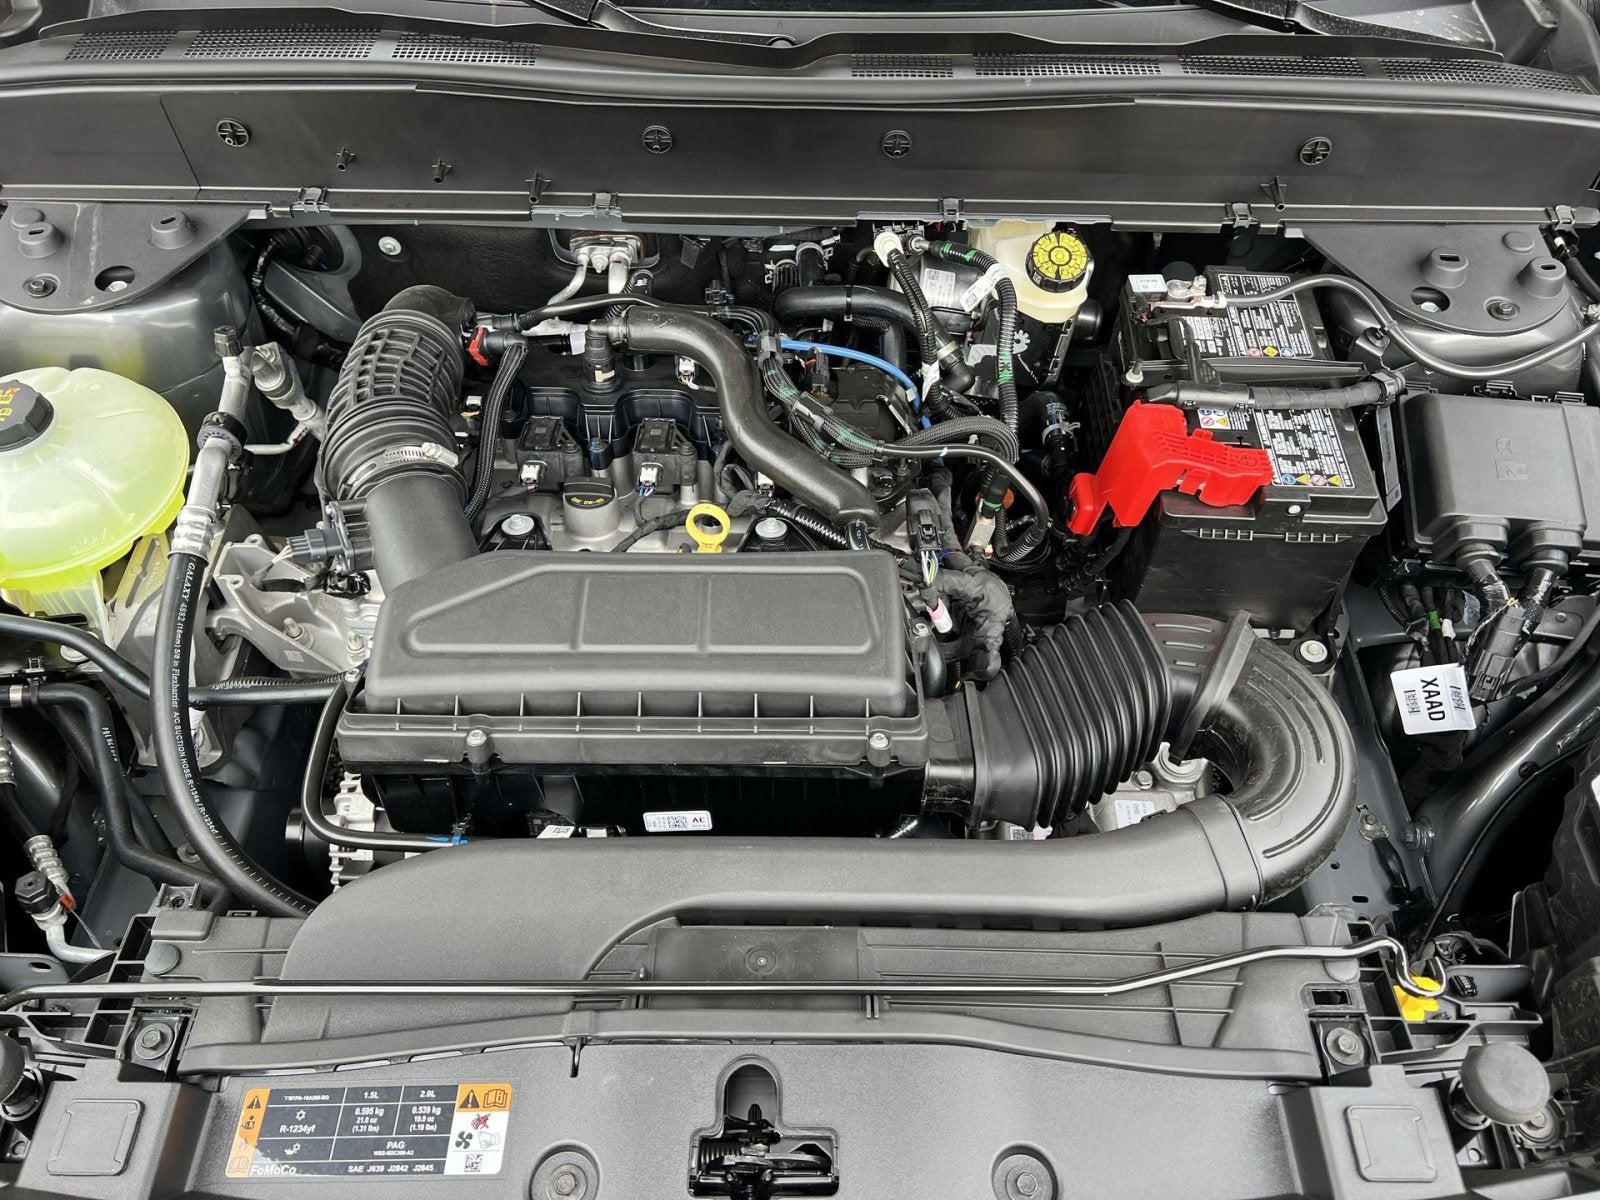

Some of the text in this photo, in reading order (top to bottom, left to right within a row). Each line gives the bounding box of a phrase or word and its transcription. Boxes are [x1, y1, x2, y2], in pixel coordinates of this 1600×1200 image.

[182, 562, 196, 602] GALAXY
[171, 668, 180, 708] Flexbarrier
[1420, 677, 1446, 721] XAAD
[172, 711, 182, 724] A/C
[174, 726, 187, 759] SUCTION
[180, 758, 192, 778] HOSE
[187, 779, 200, 803] R-134a
[363, 1091, 379, 1099] 1.5L
[419, 1090, 436, 1098] 2.0L
[354, 1107, 385, 1117] 0.595 kg
[411, 1106, 442, 1115] 0.539 kg
[279, 1124, 316, 1134] R-1234yf
[367, 1125, 380, 1133] lbs)
[425, 1123, 438, 1132] lbs)
[386, 1141, 405, 1149] PAG
[250, 1164, 297, 1176] FoMoCo
[347, 1164, 434, 1173] SAE J639 J2842 J2845
